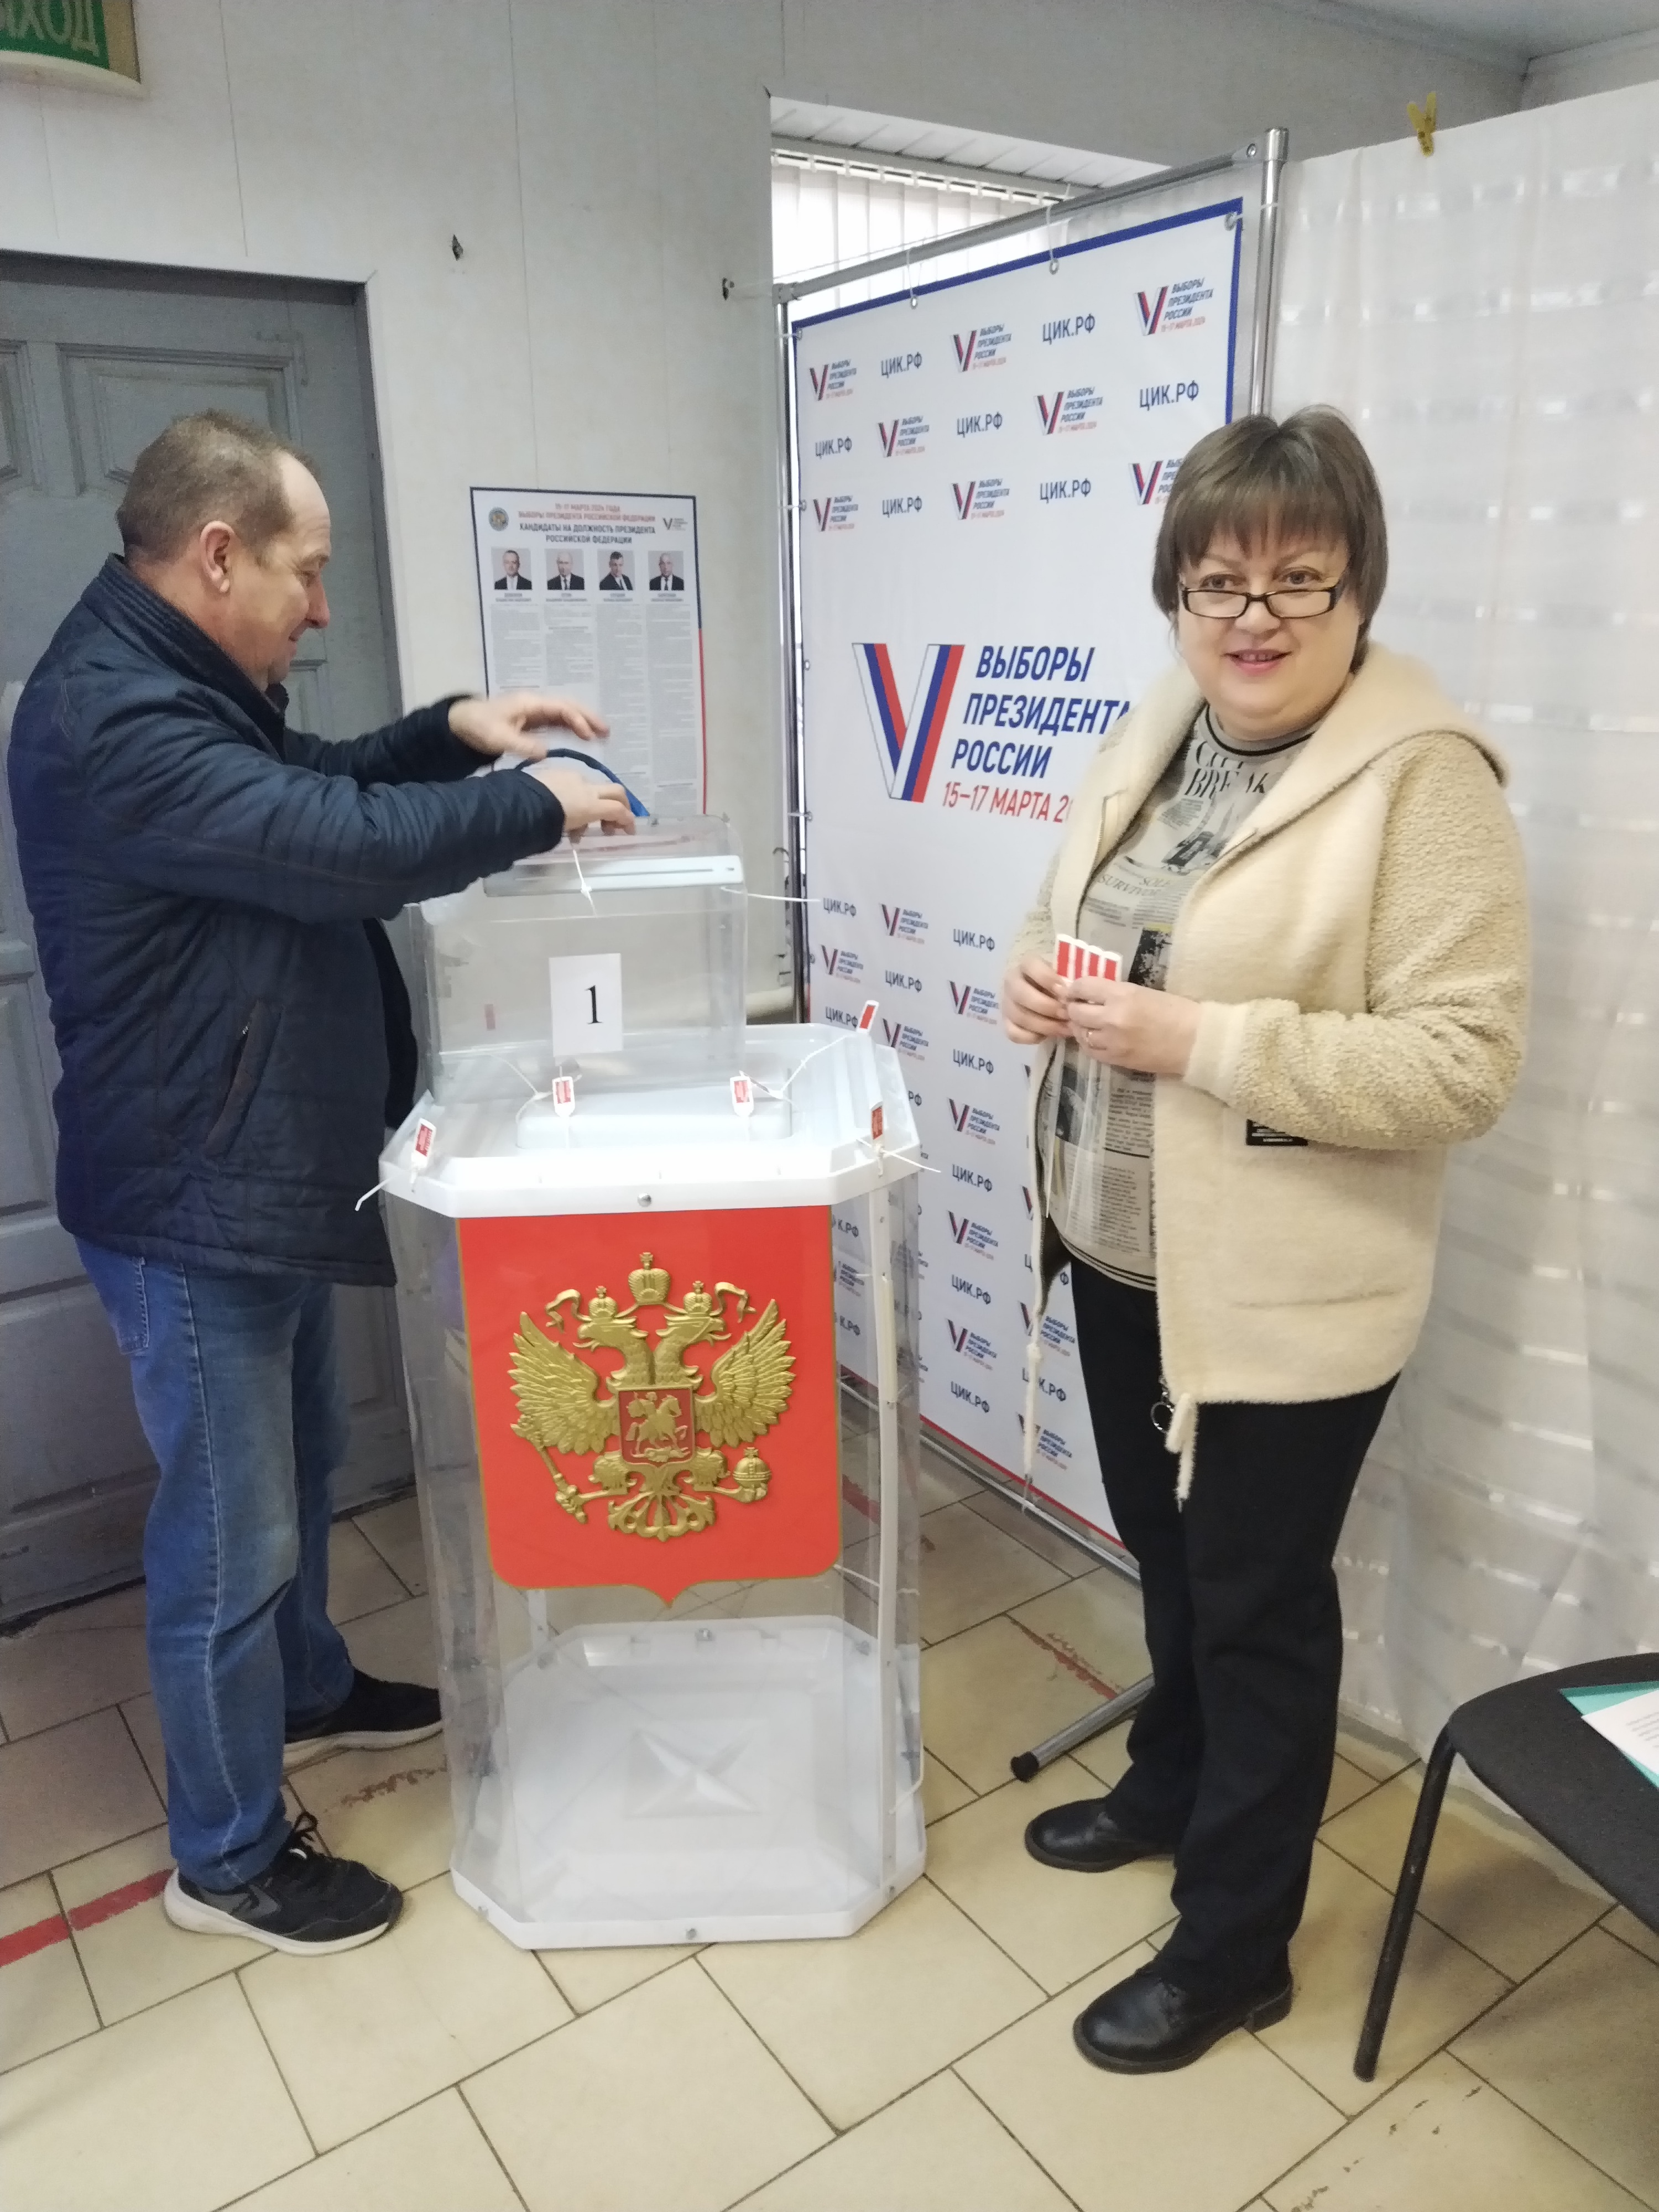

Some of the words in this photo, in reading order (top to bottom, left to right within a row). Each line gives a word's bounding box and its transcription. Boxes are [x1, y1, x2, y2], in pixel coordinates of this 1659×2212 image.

[1042, 312, 1095, 345] ЦИК.РФ
[881, 352, 922, 379] ЦИК.РФ
[1139, 379, 1199, 411] ЦИК.РФ
[957, 410, 1003, 438] ЦИК.РФ
[1040, 478, 1092, 504] ЦИК.РФ
[883, 495, 922, 518] ЦИК.РФ
[975, 645, 1095, 682] ВЫБОРЫ
[951, 739, 1053, 778] РОССИИ
[989, 786, 1051, 821] МАРТА
[953, 928, 995, 952] ЦИК.РФ
[585, 984, 603, 1024] 1
[953, 1048, 994, 1074] ЦИК.РФ
[952, 1164, 993, 1192] ЦИК.РФ
[952, 1274, 992, 1305] ЦИК.РФ
